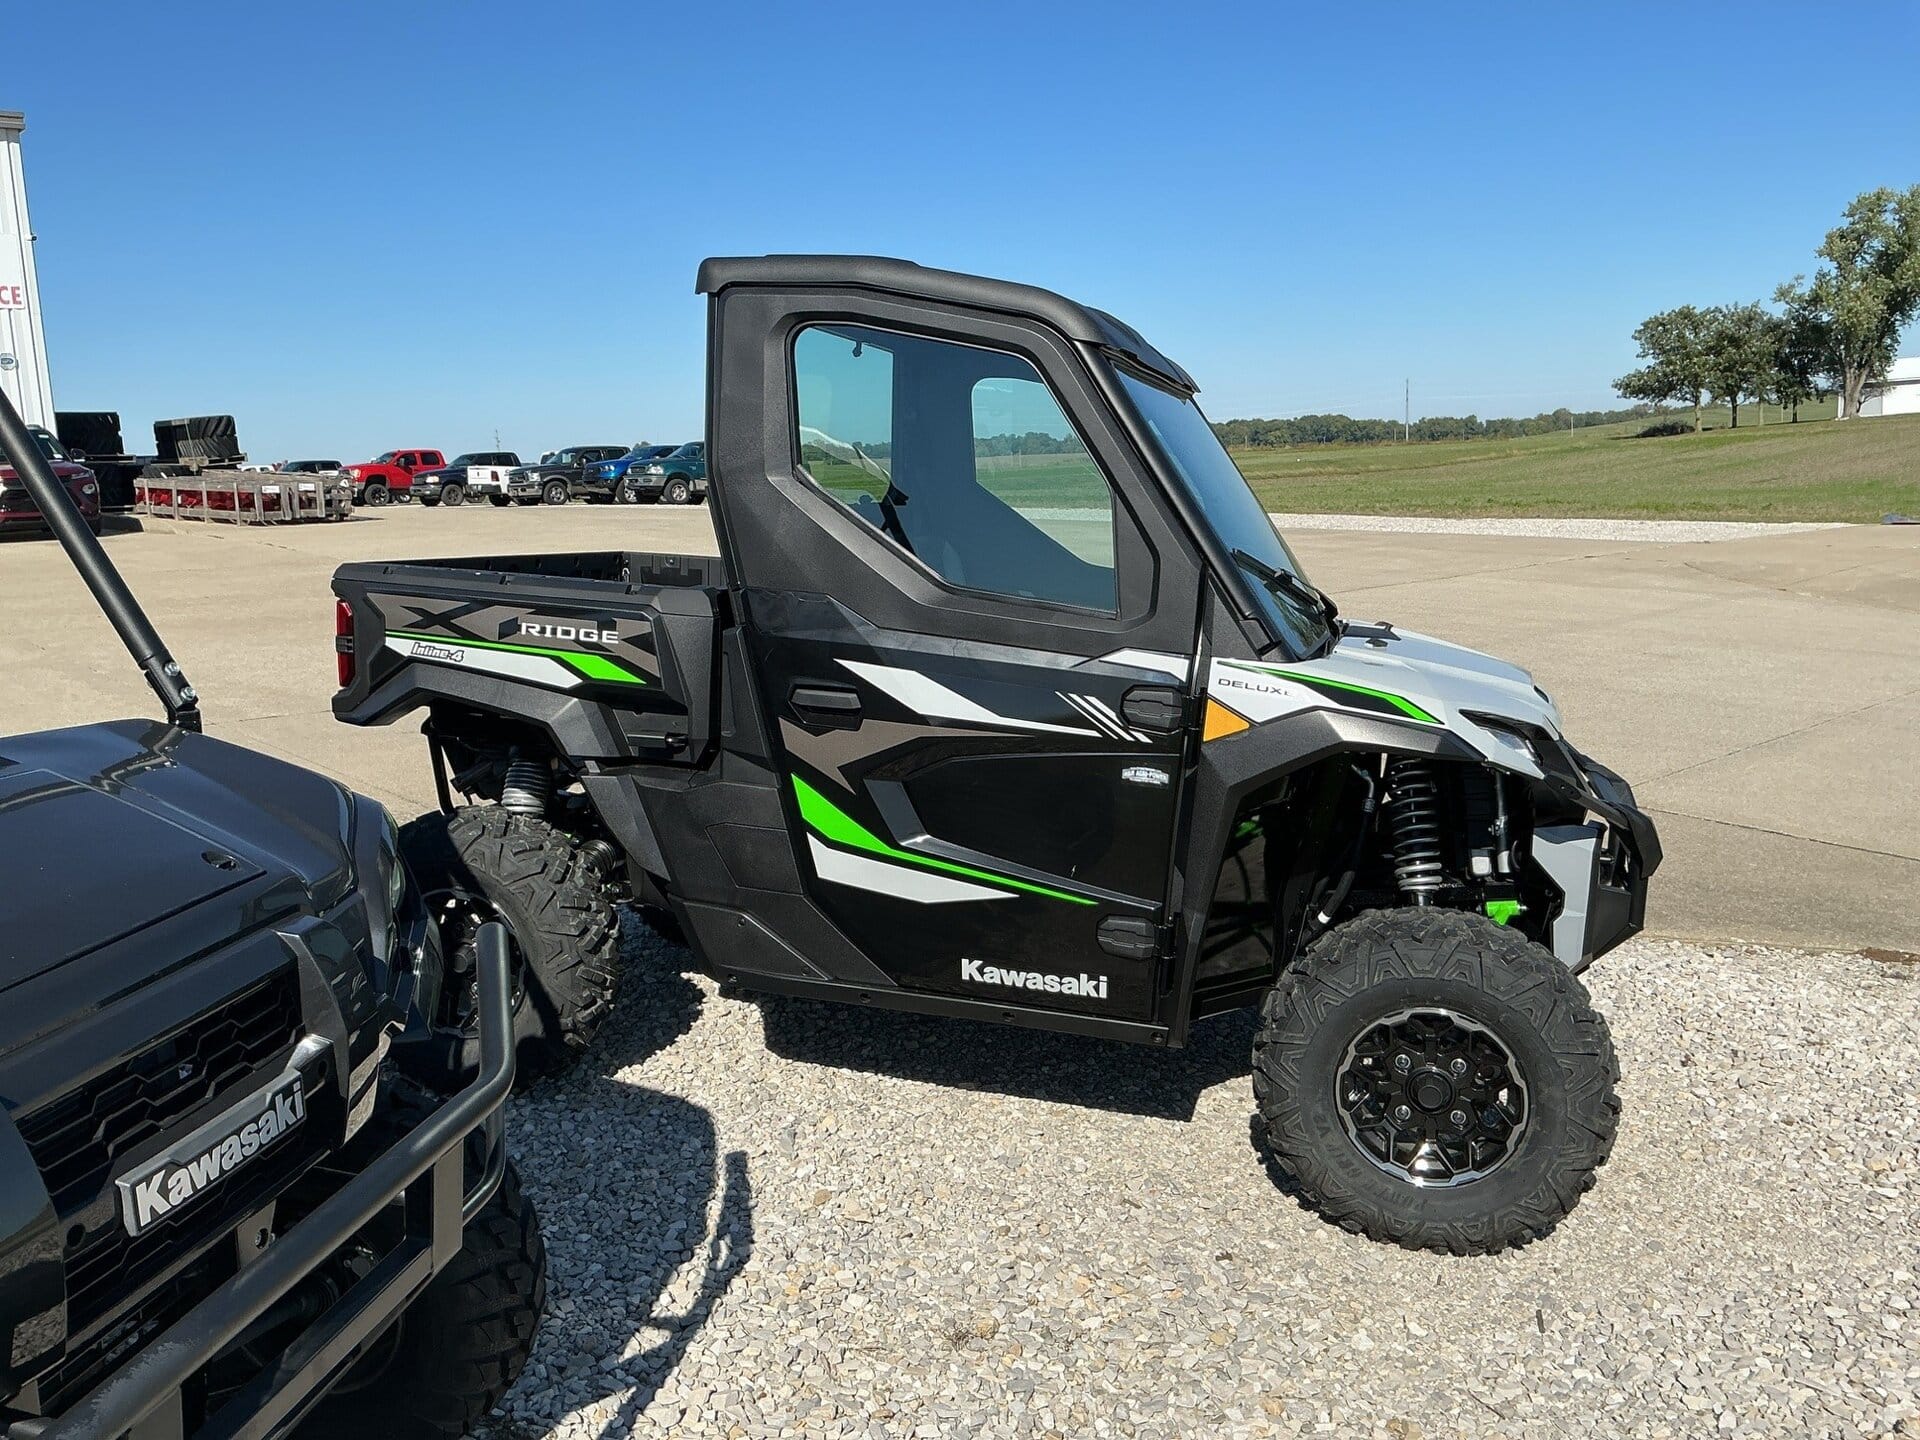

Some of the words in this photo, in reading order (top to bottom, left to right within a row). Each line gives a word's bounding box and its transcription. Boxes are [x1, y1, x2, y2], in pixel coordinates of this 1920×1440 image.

[0, 285, 22, 305] CE
[521, 622, 619, 644] RIDGE
[411, 641, 465, 662] Inline-4
[961, 958, 1108, 999] Kawasaki
[136, 1081, 304, 1227] Kawasaki
